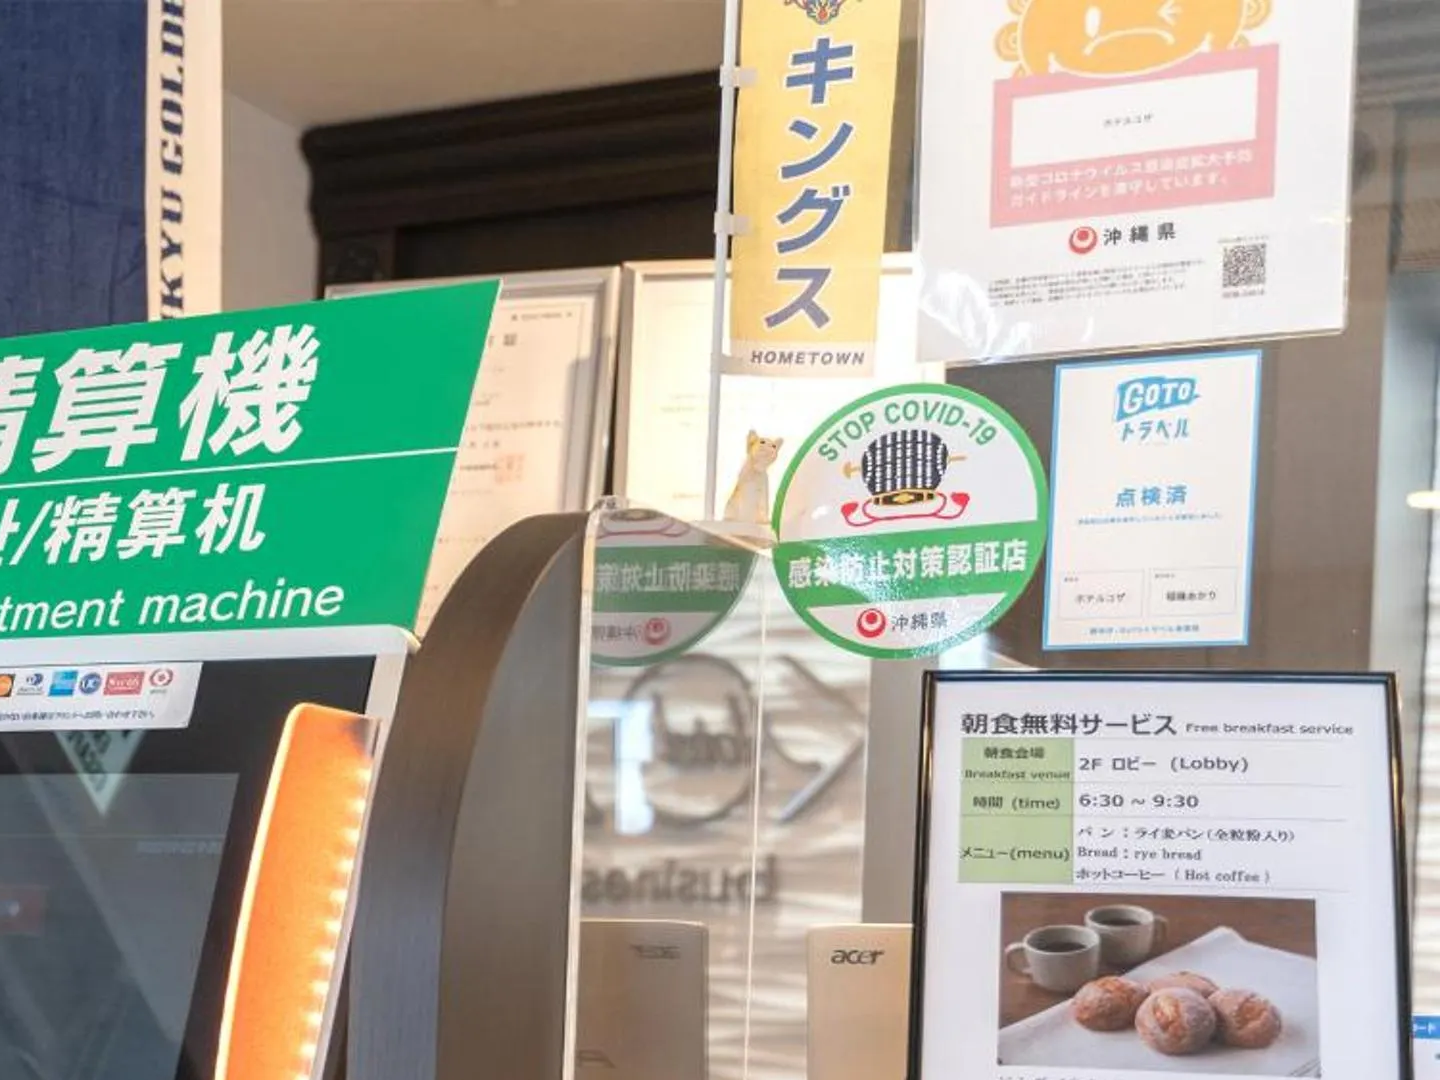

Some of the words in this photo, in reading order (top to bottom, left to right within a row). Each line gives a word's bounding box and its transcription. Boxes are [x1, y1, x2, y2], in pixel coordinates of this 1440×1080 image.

[763, 36, 856, 332] キングス
[1103, 221, 1177, 246] 沖縄県
[749, 349, 866, 367] HOMETOWN
[817, 409, 877, 463] STOP
[882, 396, 1000, 447] COVID-19
[1120, 417, 1190, 443] トラベル
[1115, 484, 1189, 509] 点検済
[137, 576, 346, 625] machine
[890, 611, 949, 633] 沖縄県
[960, 712, 1178, 736] 朝食無料サービス
[1185, 722, 1219, 734] Free
[1223, 722, 1295, 735] breakfast
[1298, 723, 1354, 736] service
[983, 745, 1045, 760] 朝食会場
[1078, 757, 1103, 771] 2F
[1111, 756, 1158, 772] ロビー
[1170, 756, 1250, 774] (Lobby)
[972, 795, 1004, 810] 時間
[1011, 796, 1061, 811] (time)
[1078, 793, 1125, 808] 6:30
[1152, 793, 1200, 809] 9:30
[1162, 848, 1202, 861] bread
[1075, 867, 1166, 882] ホットコーヒー
[830, 946, 885, 966] acer
